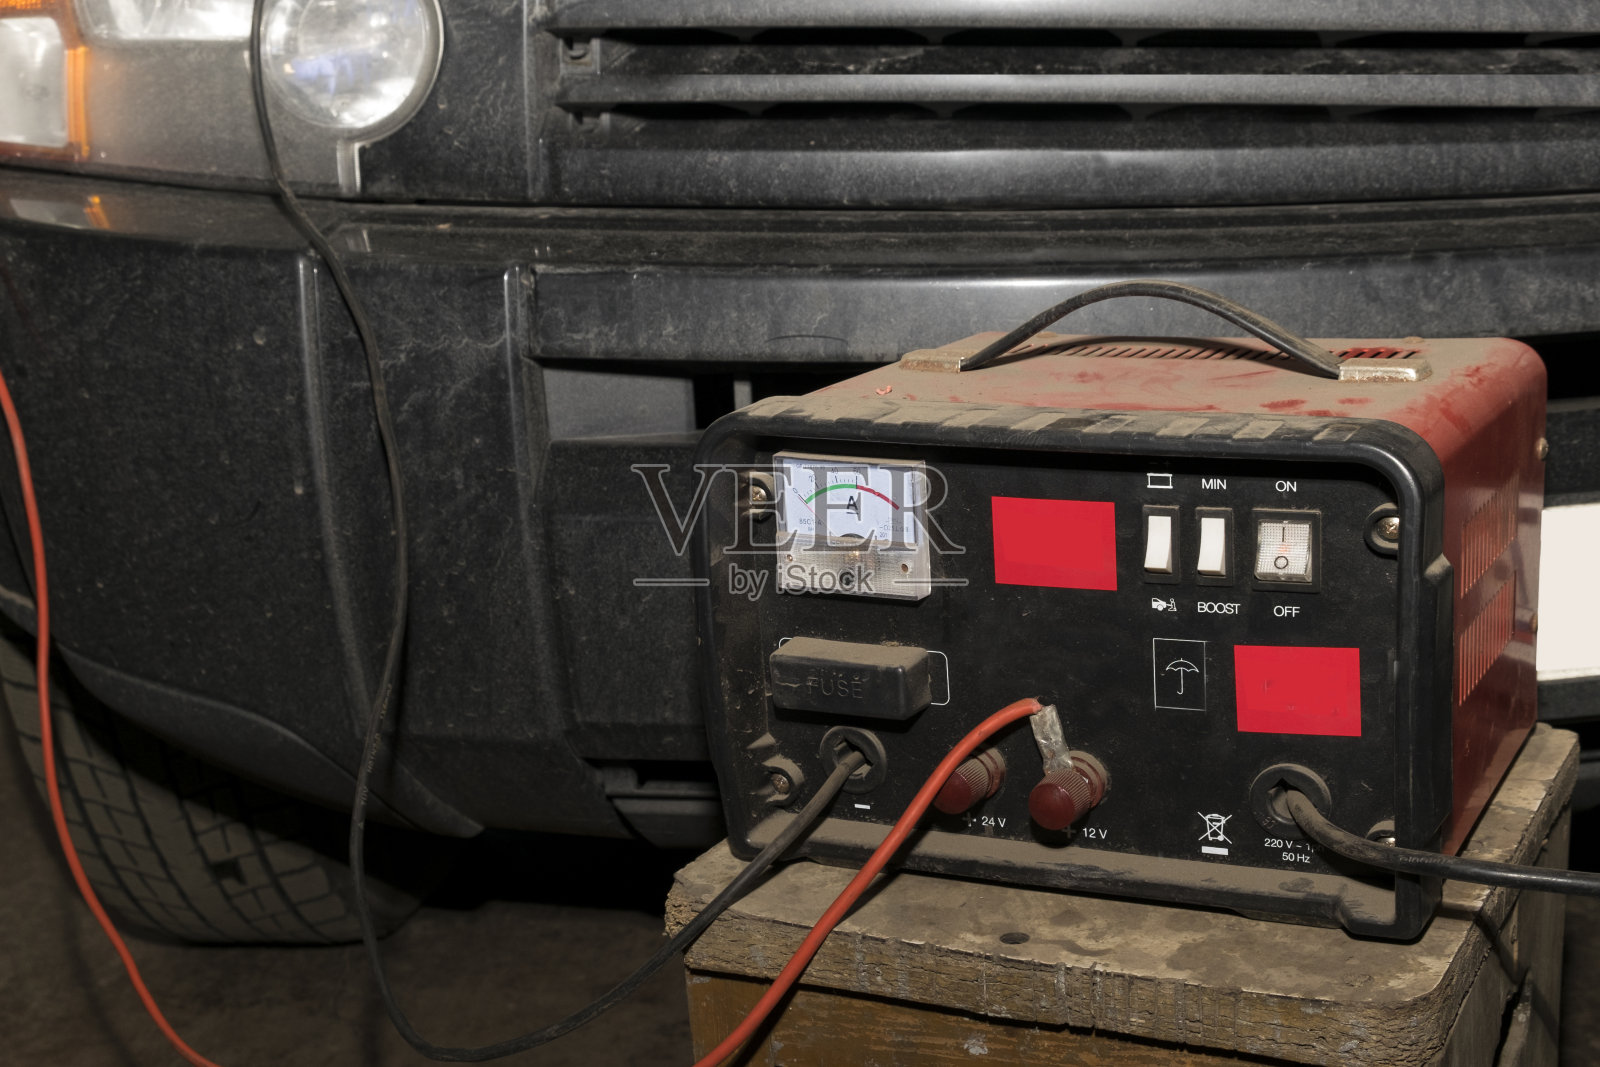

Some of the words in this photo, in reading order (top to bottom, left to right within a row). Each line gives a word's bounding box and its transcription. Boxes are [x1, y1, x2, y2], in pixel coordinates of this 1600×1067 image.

[1201, 478, 1227, 490] MIN
[1275, 480, 1297, 492] ON
[846, 495, 859, 511] A
[1197, 601, 1241, 614] BOOST
[1273, 605, 1300, 618] OFF
[806, 676, 864, 699] FUSE
[981, 815, 995, 827] 24
[998, 817, 1006, 828] V
[1082, 827, 1096, 839] 12
[1099, 828, 1108, 840] V
[1264, 838, 1283, 849] 220
[1285, 840, 1294, 849] V
[1282, 851, 1295, 862] 50
[1297, 853, 1311, 864] Hz
